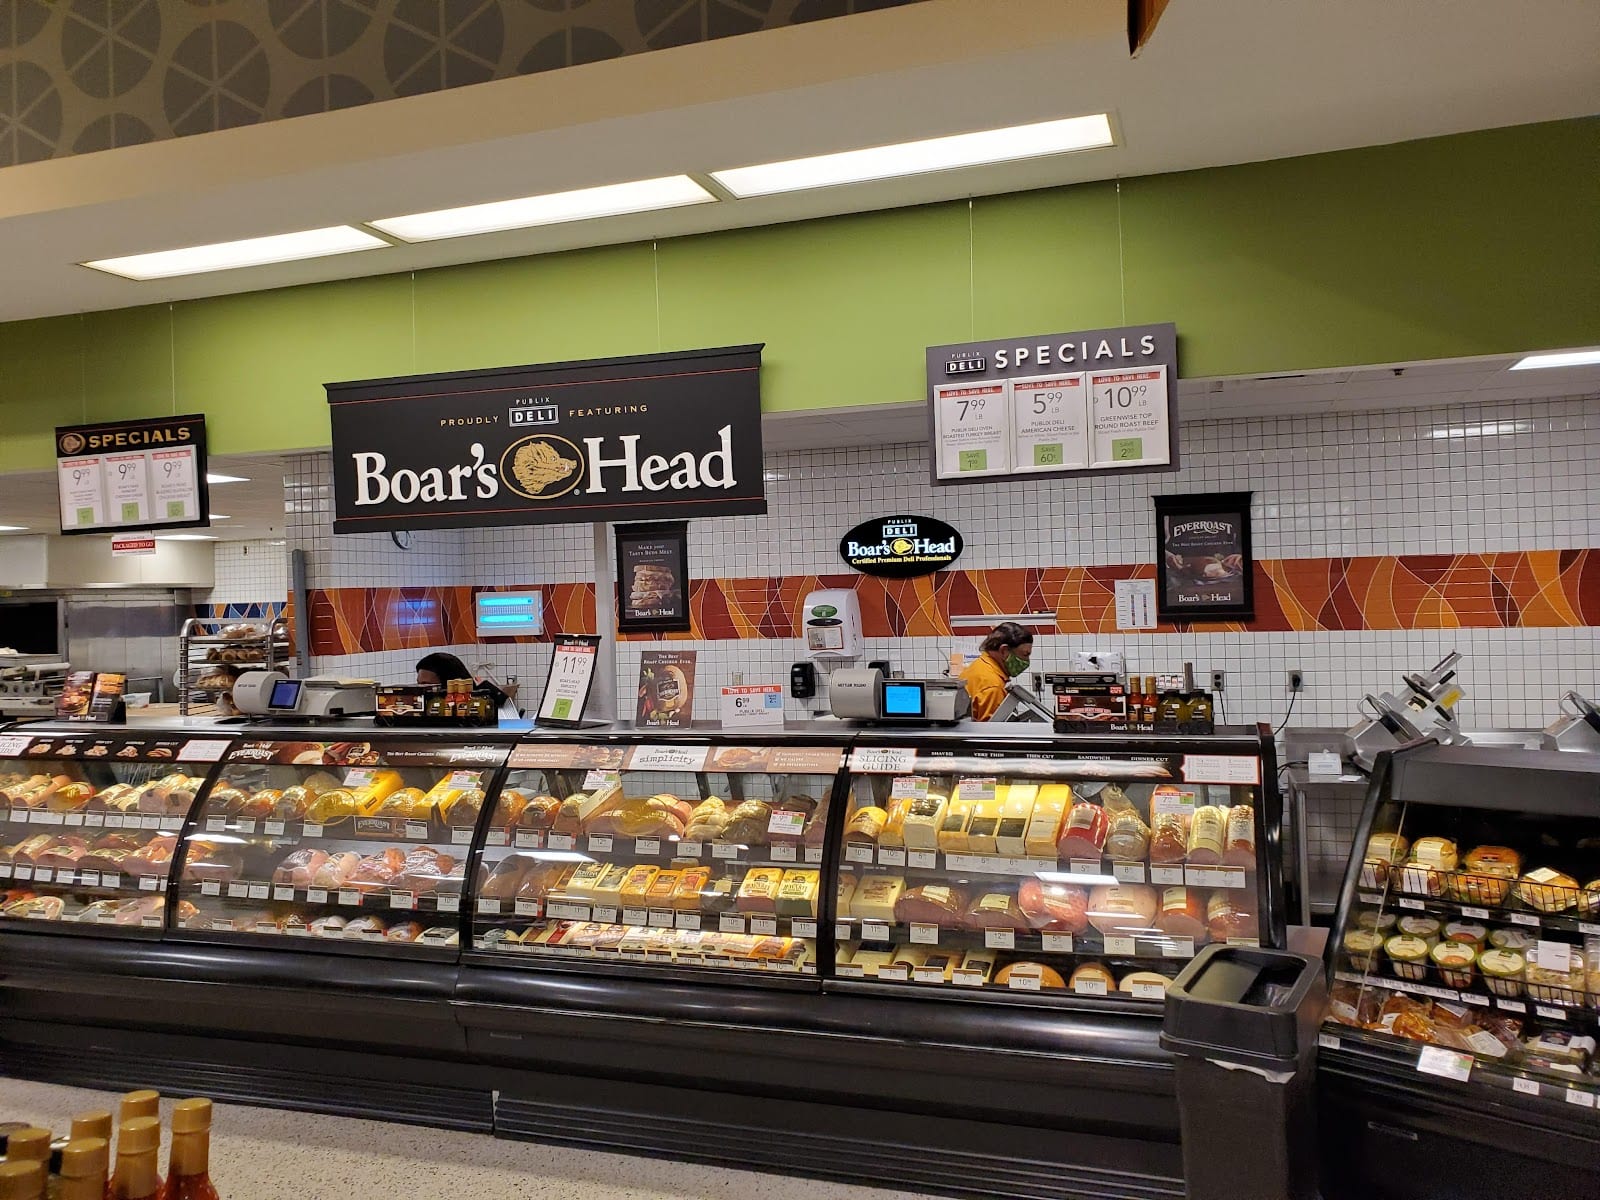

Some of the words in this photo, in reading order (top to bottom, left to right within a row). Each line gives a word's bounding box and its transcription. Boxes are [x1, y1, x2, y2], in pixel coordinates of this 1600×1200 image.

[951, 351, 980, 359] PUBLIX
[994, 335, 1156, 370] SPECIALS
[949, 361, 982, 372] DELI
[515, 396, 550, 405] PUBLIX
[440, 415, 499, 427] PROUDLY
[514, 408, 554, 423] DELI
[568, 404, 648, 418] FEATURING
[1100, 414, 1137, 422] GREENWISE
[88, 427, 191, 449] SPECIALS
[352, 441, 498, 507] Boar's
[582, 424, 737, 494] Head
[886, 527, 914, 535] DELI
[1173, 521, 1233, 538] EVERROAST
[848, 539, 891, 557] Boar's
[913, 535, 956, 554] Head
[877, 556, 902, 564] Premium
[1178, 594, 1200, 602] Boar's
[1210, 593, 1231, 602] Head
[634, 609, 651, 617] Boar's
[659, 607, 674, 616] Head
[1110, 723, 1127, 731] Boar's
[639, 754, 695, 765] simplicity
[858, 755, 907, 763] SLICING
[862, 763, 901, 771] GUIDE
